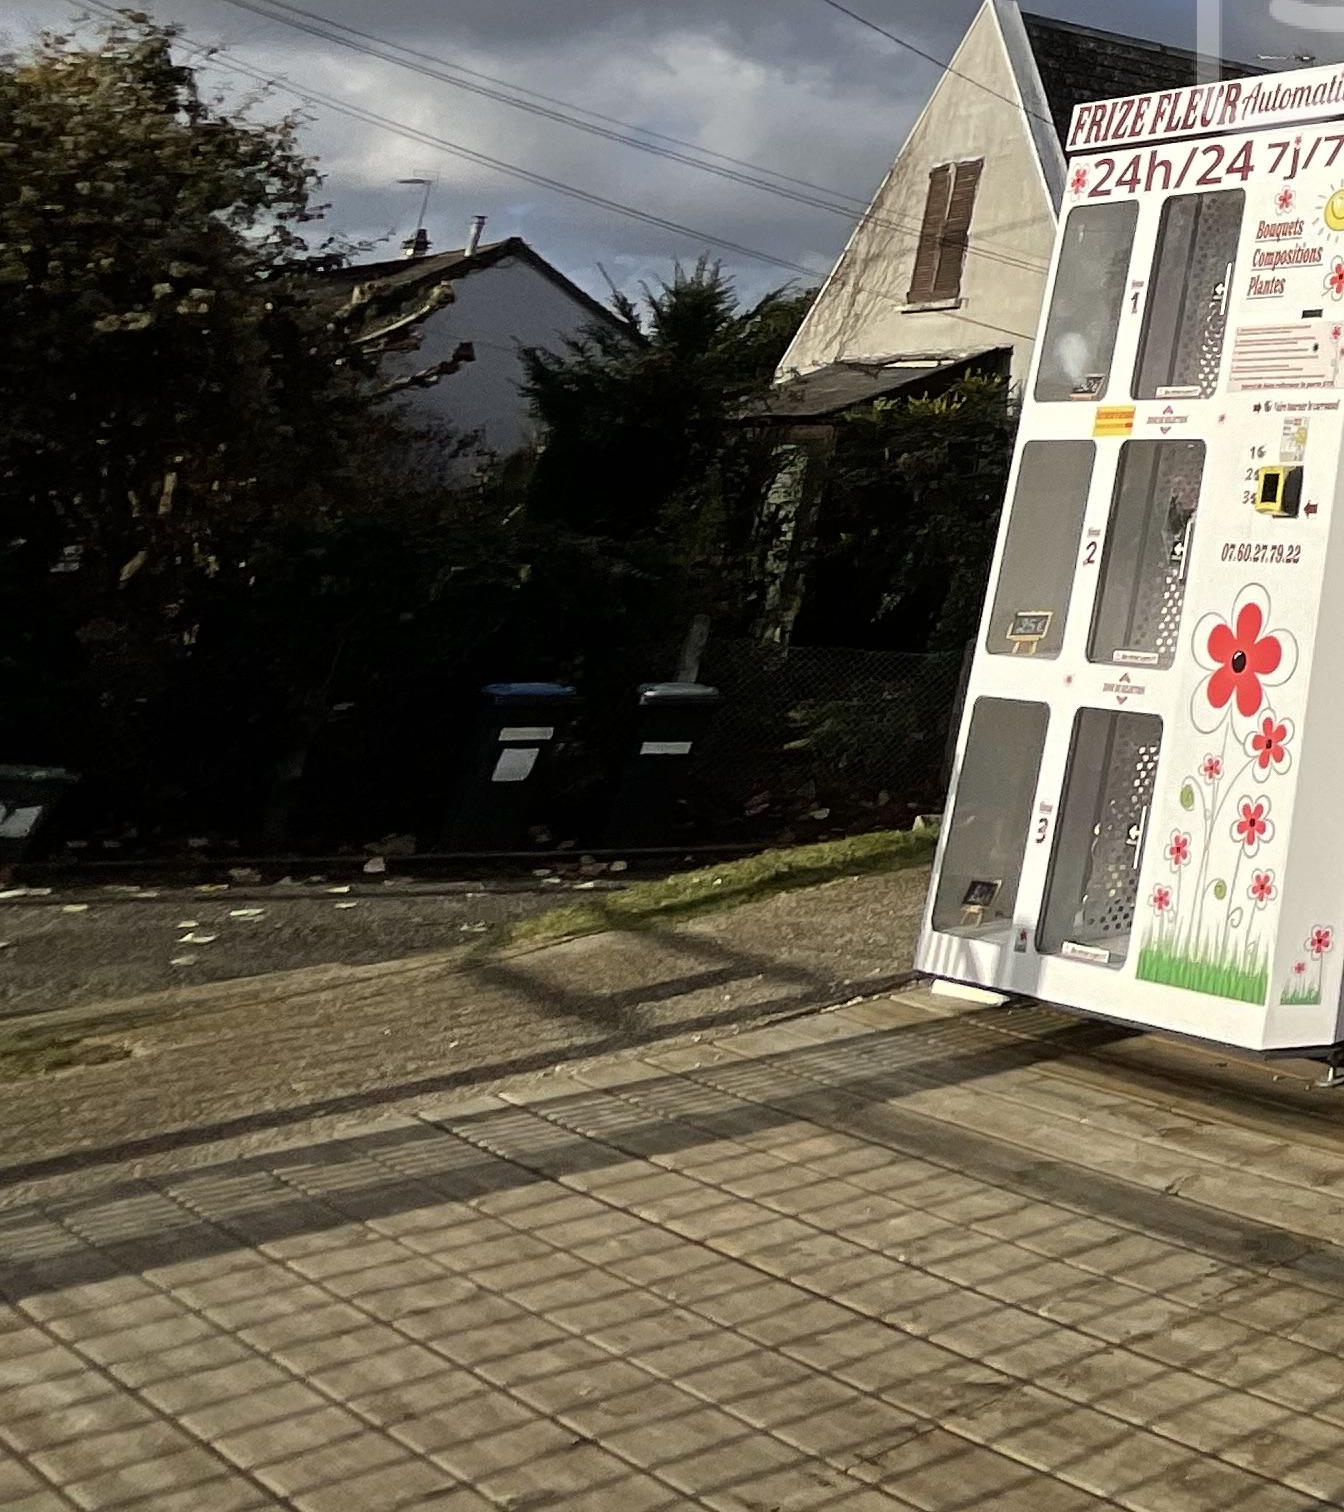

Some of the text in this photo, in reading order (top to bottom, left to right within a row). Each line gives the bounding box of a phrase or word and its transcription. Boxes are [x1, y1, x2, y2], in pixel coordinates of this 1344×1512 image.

[1068, 96, 1152, 146] FRIZE
[1149, 82, 1242, 136] FLEUR
[1088, 140, 1255, 198] 24h/24
[1256, 217, 1304, 242] Bouquets
[1252, 243, 1323, 271] Compositions
[1246, 274, 1286, 296] Plantes
[1130, 291, 1140, 314] 1
[1083, 541, 1097, 566] 2
[1221, 543, 1302, 564] 07.60.27.79.22
[1035, 817, 1049, 844] 3
